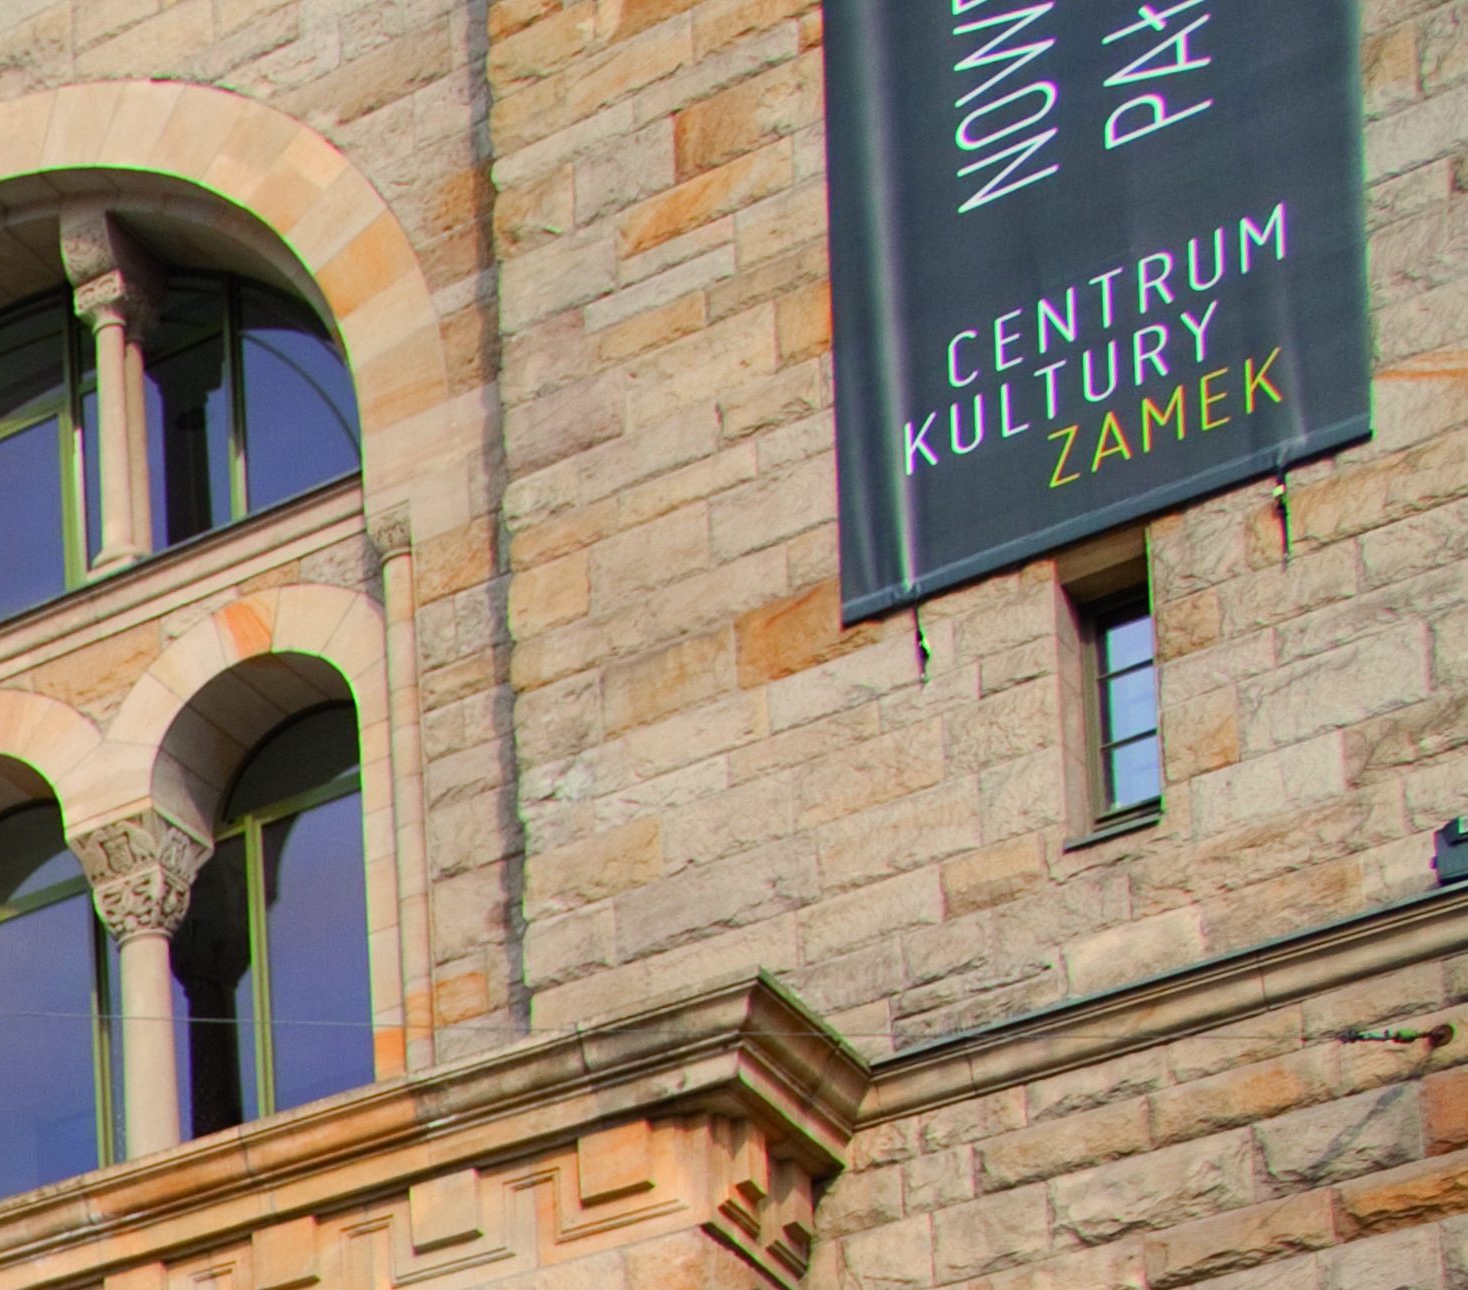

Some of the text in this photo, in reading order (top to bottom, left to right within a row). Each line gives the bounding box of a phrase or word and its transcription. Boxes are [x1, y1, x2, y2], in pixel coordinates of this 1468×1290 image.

[947, 202, 1287, 388] CENTRUM
[903, 301, 1217, 476] KULTURY
[1047, 346, 1283, 488] ZAMEK
